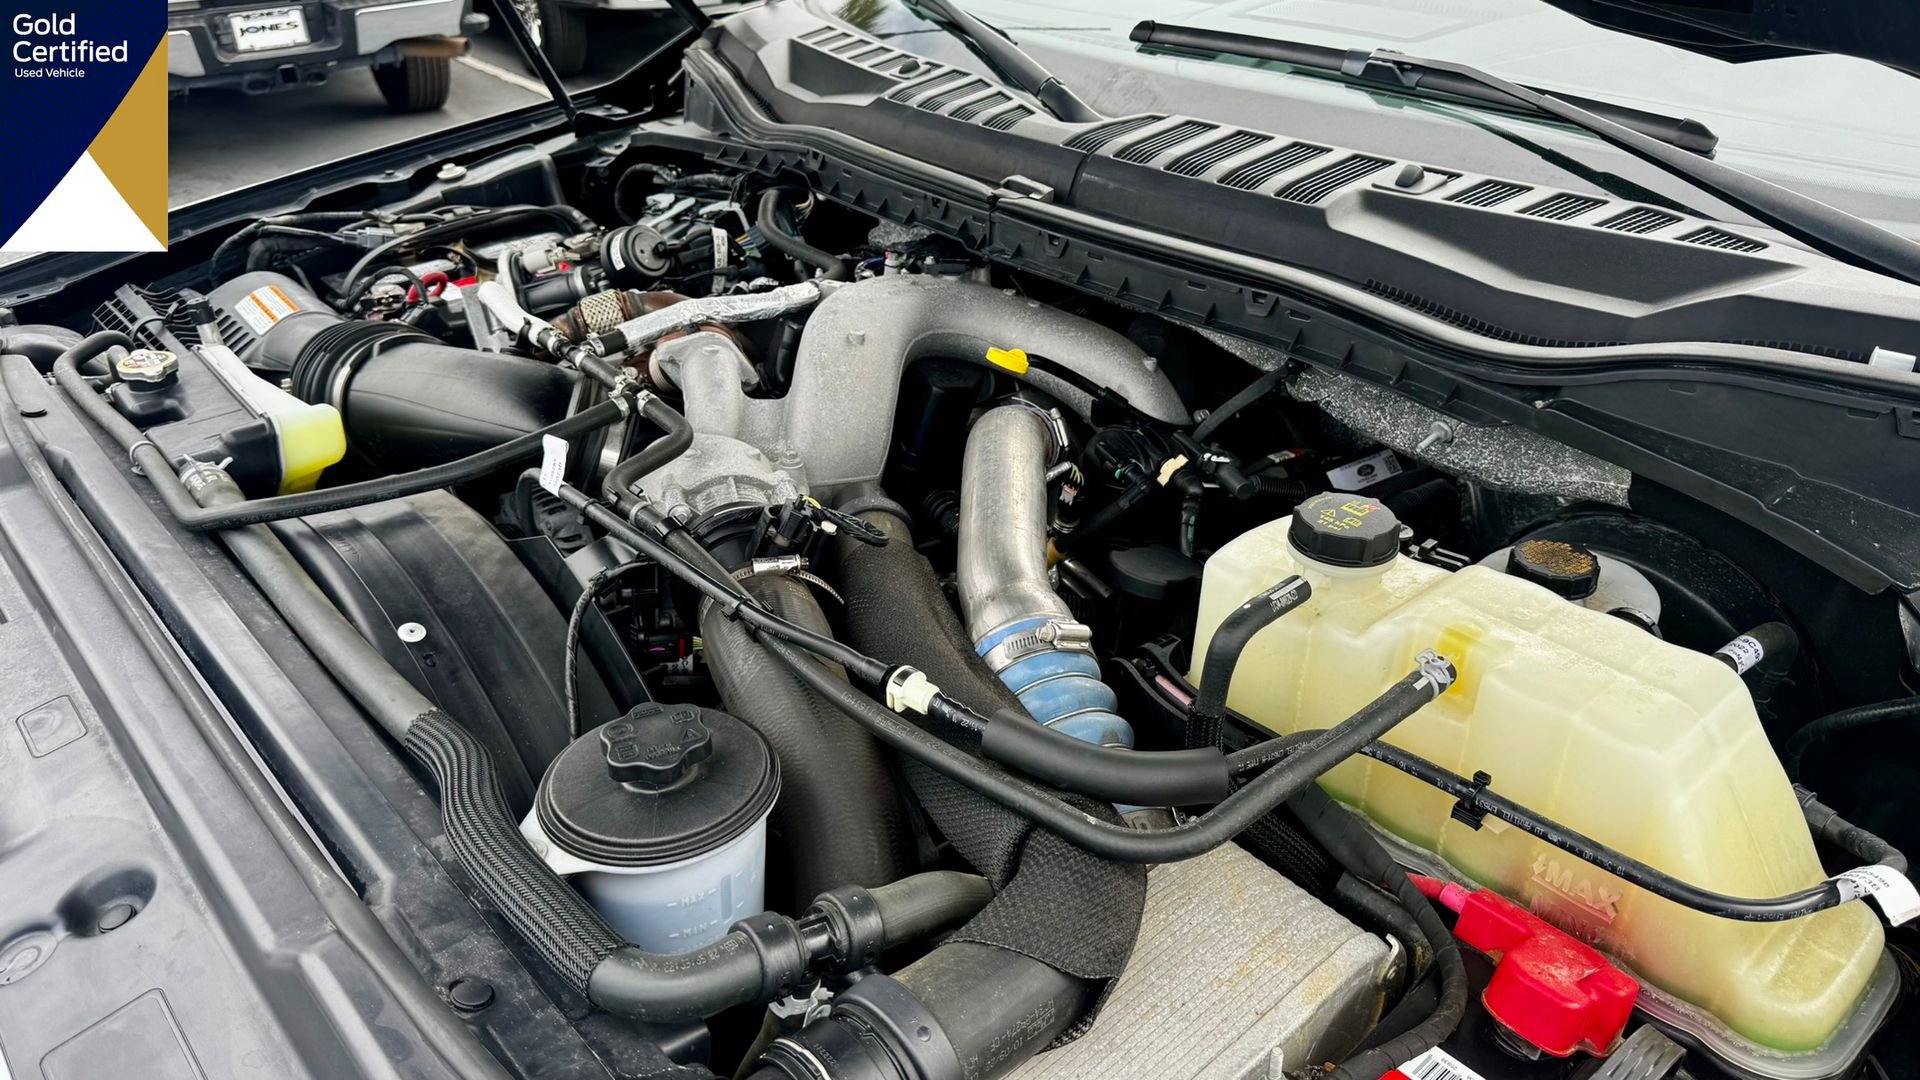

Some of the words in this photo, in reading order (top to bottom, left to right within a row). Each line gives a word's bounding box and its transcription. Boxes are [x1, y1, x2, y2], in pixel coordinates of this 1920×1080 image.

[240, 21, 299, 37] JONES
[681, 890, 706, 908] MAX
[1545, 861, 1622, 921] MAX
[682, 922, 708, 938] MIN
